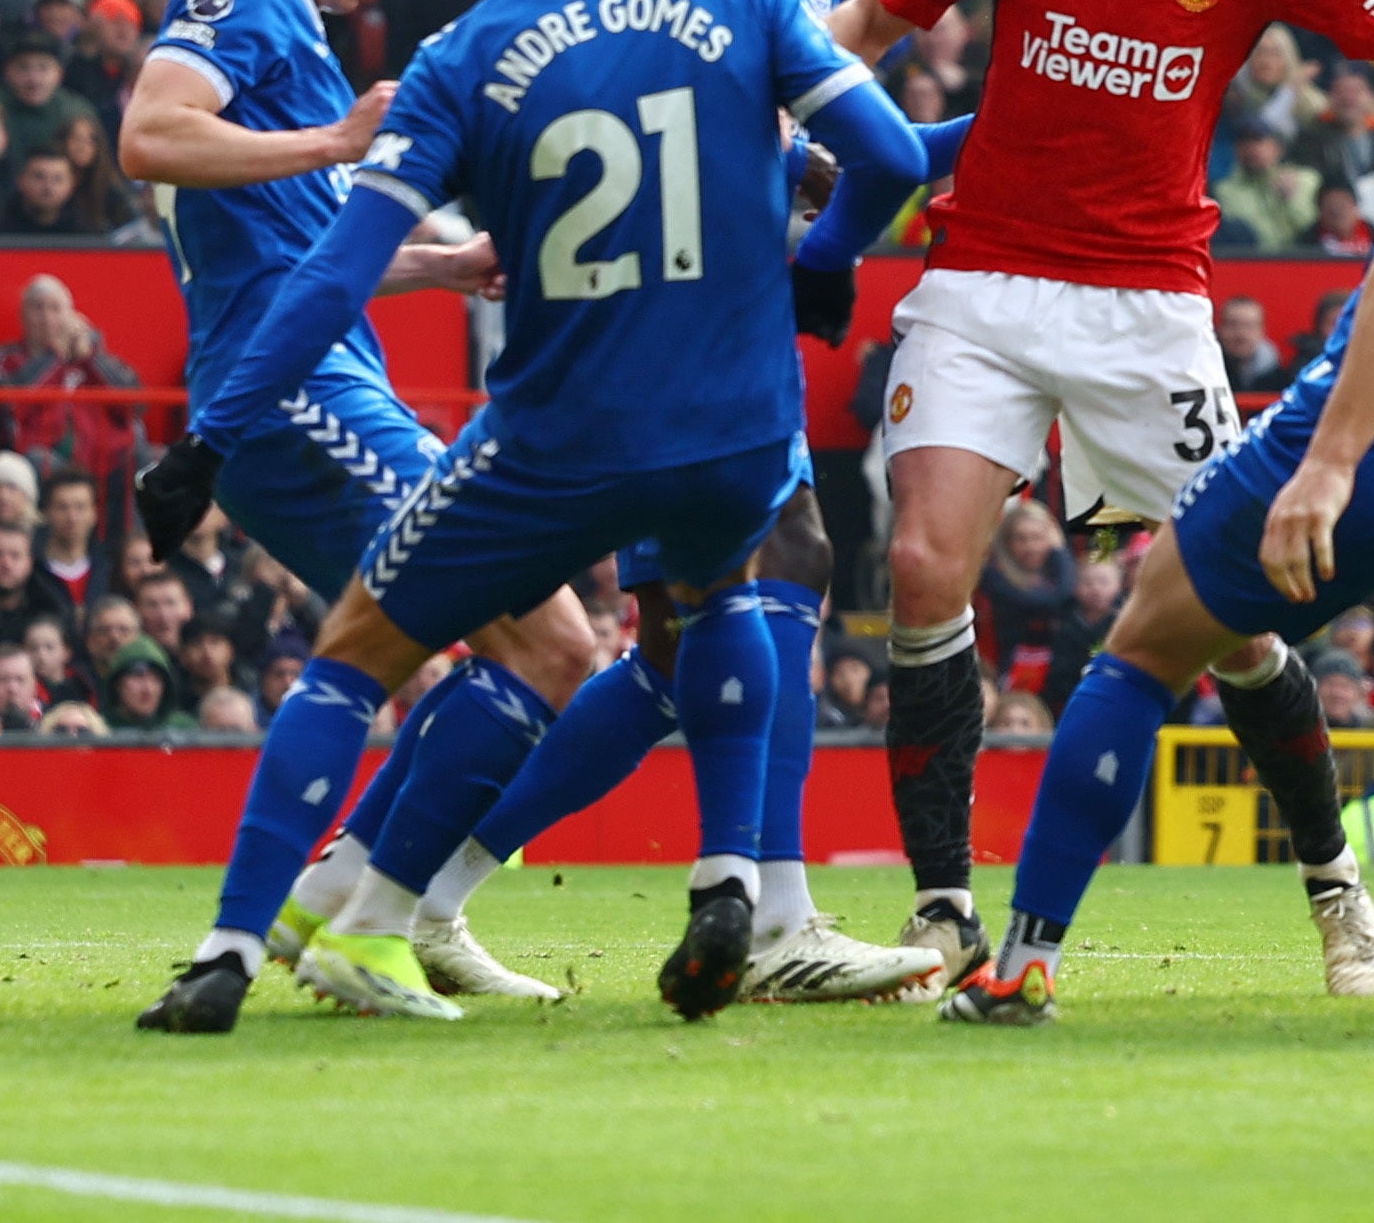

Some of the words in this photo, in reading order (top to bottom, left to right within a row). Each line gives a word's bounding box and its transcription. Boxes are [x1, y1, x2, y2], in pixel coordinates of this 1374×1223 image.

[1020, 29, 1153, 100] Viewer
[1045, 10, 1159, 70] Team
[530, 86, 704, 301] 21
